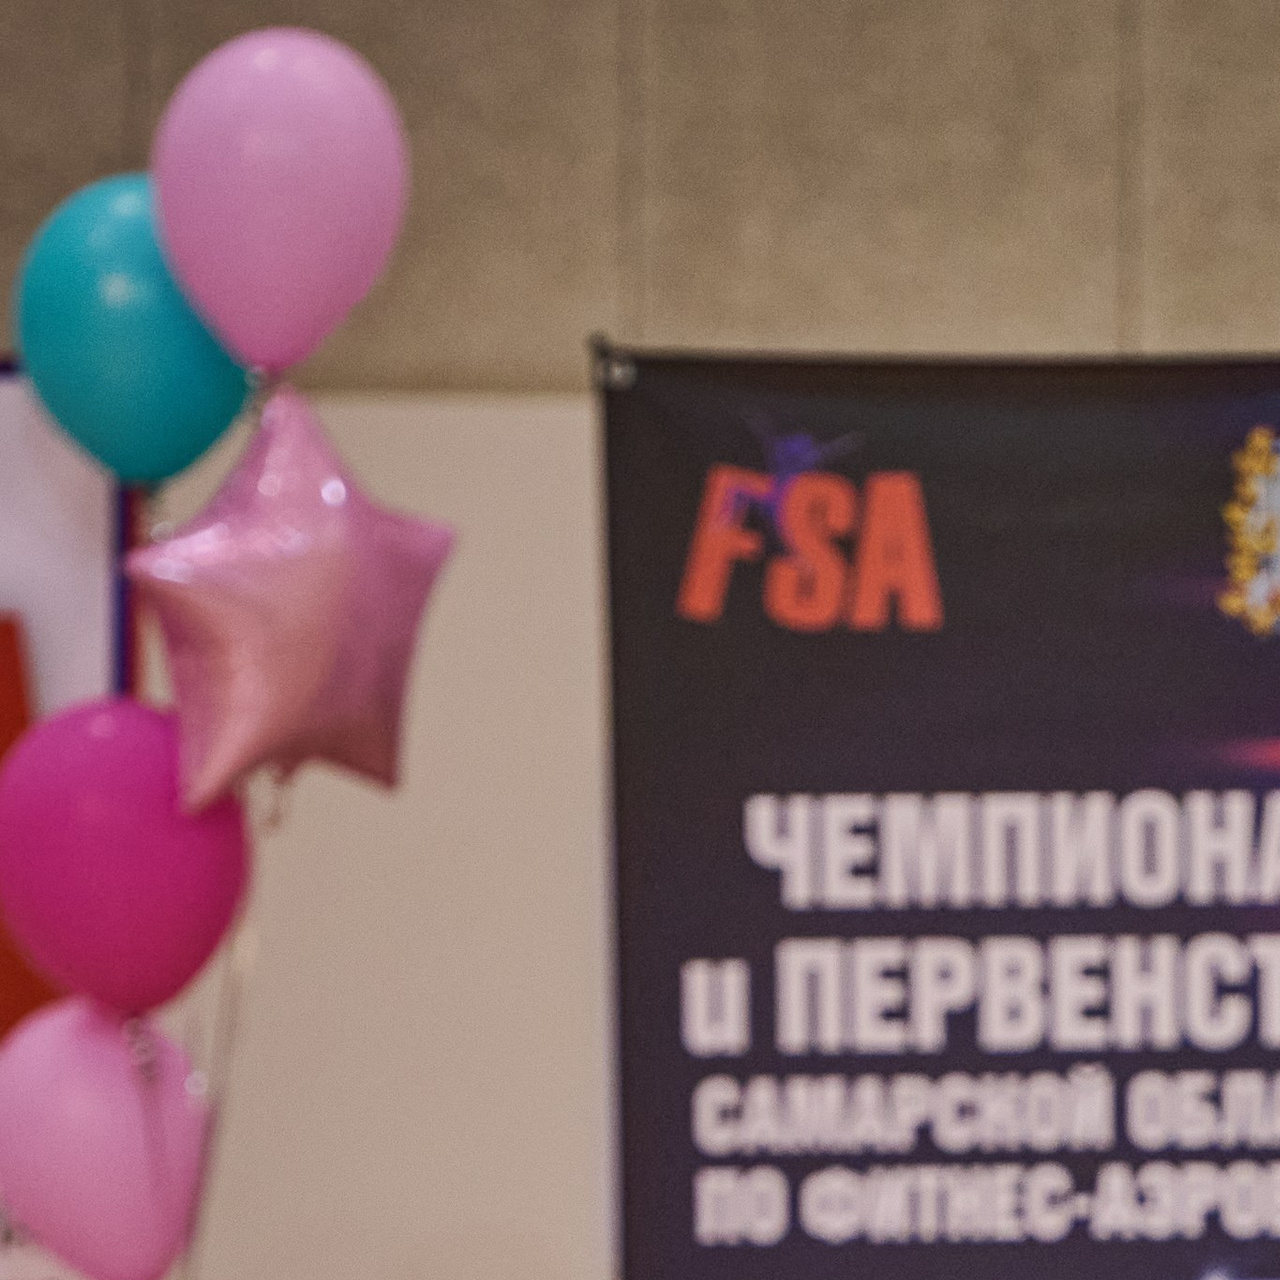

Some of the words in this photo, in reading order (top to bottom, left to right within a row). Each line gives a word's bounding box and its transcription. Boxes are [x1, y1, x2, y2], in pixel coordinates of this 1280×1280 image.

[678, 464, 943, 632] FSA
[691, 1062, 1117, 1157] САМАРСКОЙ
[692, 1163, 791, 1247] ПО
